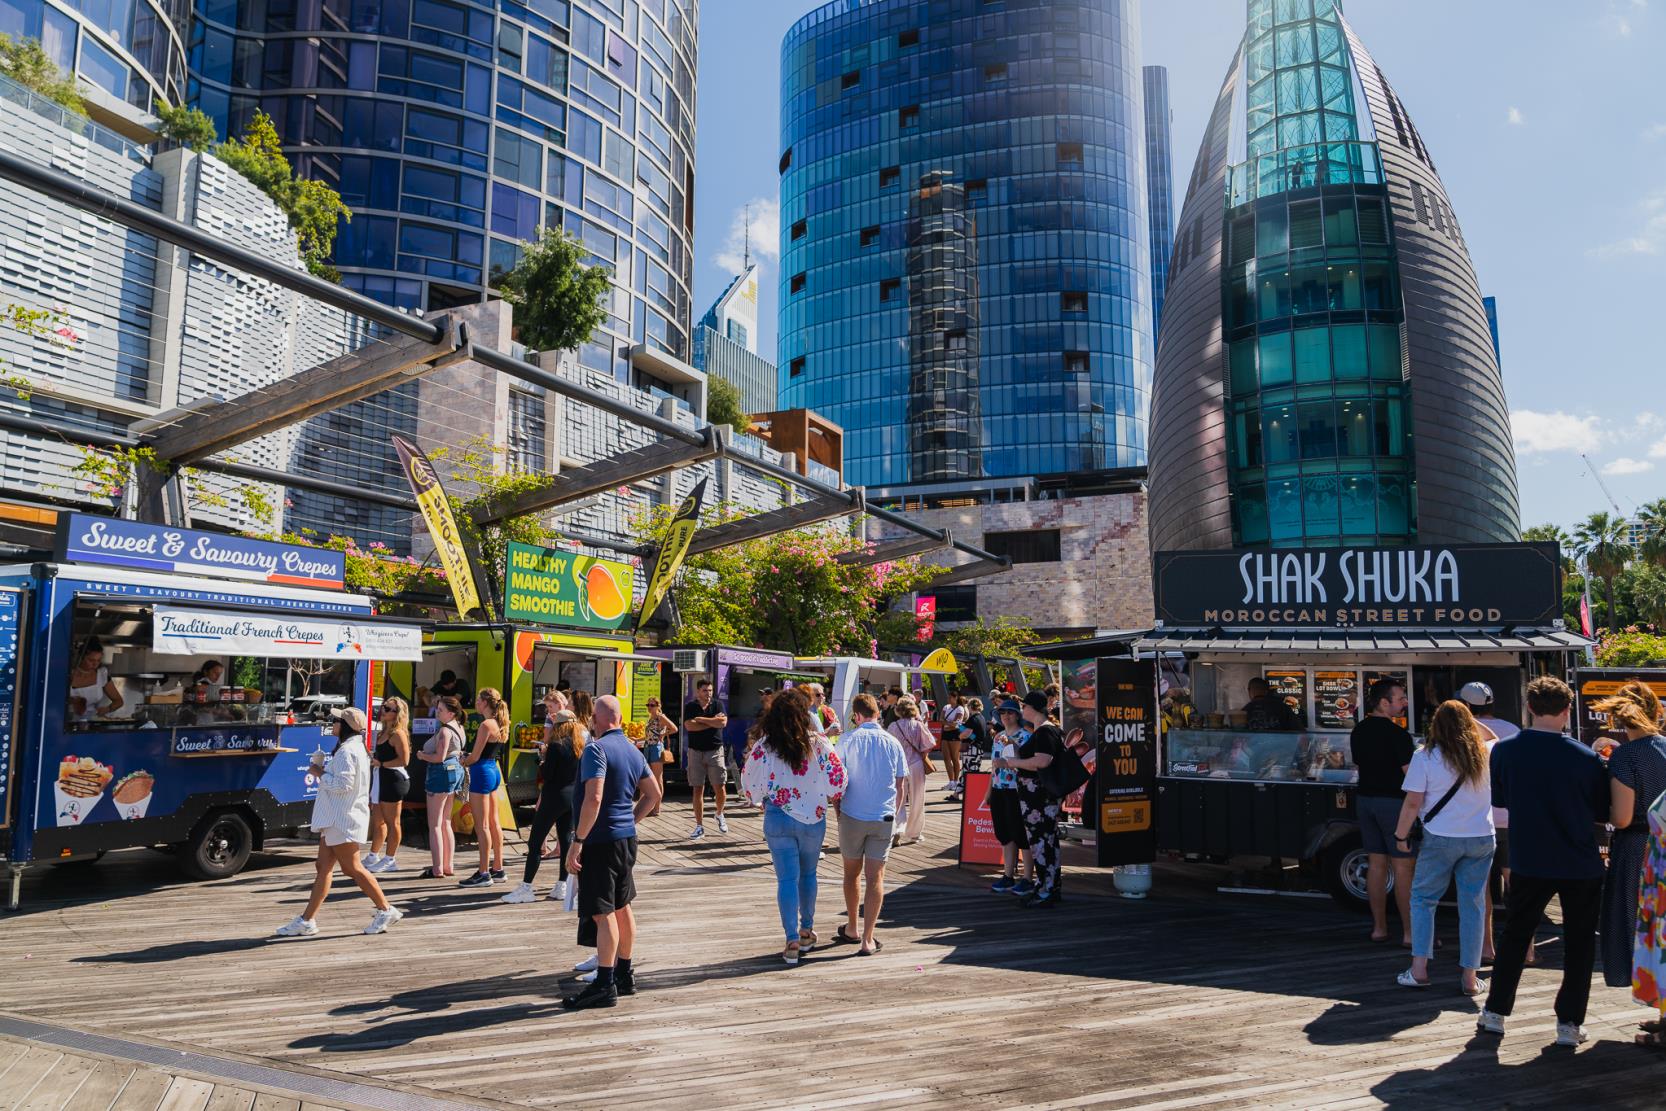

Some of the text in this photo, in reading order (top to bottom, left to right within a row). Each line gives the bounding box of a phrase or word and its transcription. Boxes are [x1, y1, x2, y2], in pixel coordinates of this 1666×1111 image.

[81, 522, 337, 578] Sweet & Savoury Crepes
[512, 550, 567, 574] HEALTHY
[511, 572, 560, 594] MANGO
[1239, 549, 1460, 604] SHAK SHUKA
[87, 582, 127, 593] SWEET
[150, 589, 200, 599] SAVOURY
[207, 594, 276, 605] TRADITIONAL
[281, 600, 315, 609] FRENCH
[320, 604, 353, 612] CREPES
[510, 593, 575, 617] SMOOTHIE
[1204, 608, 1502, 623] MOROCCAN STREET FOOD
[160, 616, 324, 642] Traditional French Crepes
[1106, 706, 1143, 721] WE CAN
[1104, 723, 1146, 743] COME
[176, 736, 211, 752] Sweet
[1119, 744, 1131, 757] TO
[1113, 758, 1137, 775] YOU
[968, 817, 994, 826] Pedes
[976, 826, 995, 834] Bew
